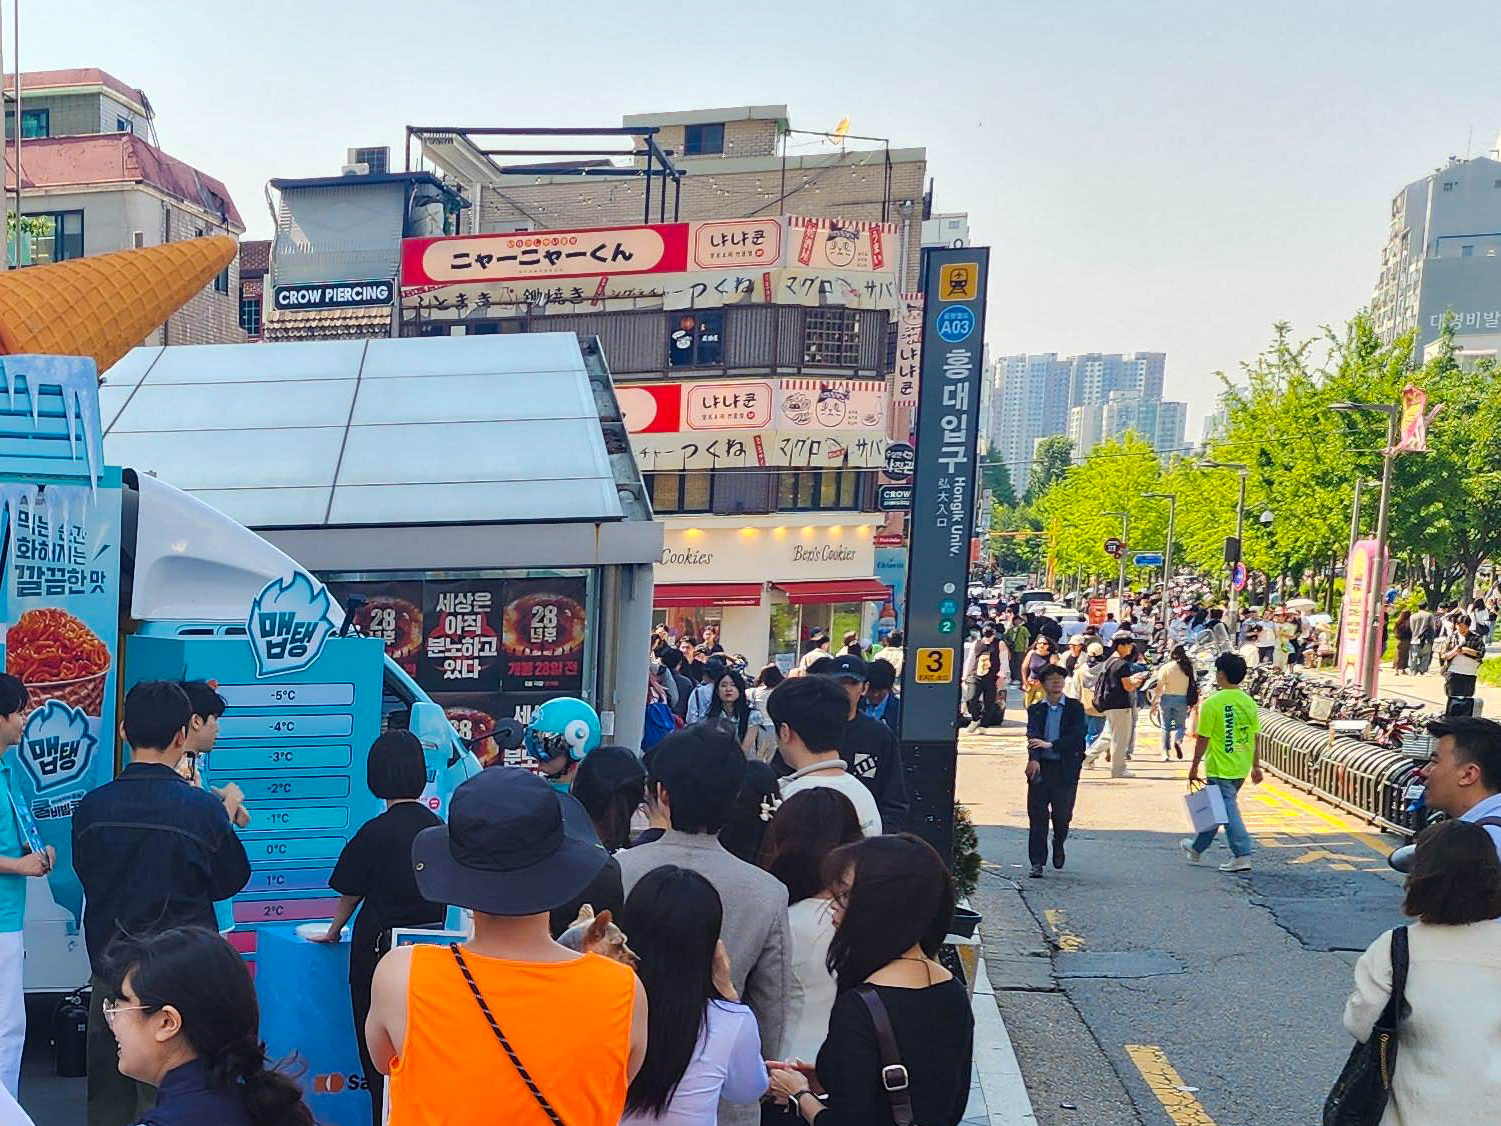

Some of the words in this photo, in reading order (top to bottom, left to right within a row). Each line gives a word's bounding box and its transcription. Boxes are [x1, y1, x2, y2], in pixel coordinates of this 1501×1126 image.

[450, 242, 634, 271] ニャーニャーくん
[278, 289, 322, 305] CROW
[325, 285, 389, 303] PIERCING
[786, 276, 833, 295] マグロ
[864, 280, 894, 299] サバ
[940, 320, 970, 335] A03
[937, 348, 973, 474] 홍대입구
[681, 438, 747, 460] つくね
[780, 438, 821, 457] マグロ
[855, 438, 884, 458] サバ
[884, 490, 912, 498] CROW
[936, 477, 951, 528] 弘大入口
[949, 476, 966, 523] Hongik
[948, 524, 964, 557] Univ.
[793, 545, 821, 562] Ben's
[821, 544, 857, 561] Cookies
[15, 564, 87, 598] 깔끔한
[89, 570, 106, 595] 맛
[435, 591, 493, 613] 세상은
[370, 608, 396, 631] 28
[444, 614, 482, 636] 아직
[529, 604, 558, 628] 28
[942, 621, 951, 632] 2
[257, 611, 319, 660] 맵탱
[427, 636, 498, 658] 분노하고
[443, 659, 482, 680] 있다
[926, 650, 944, 672] 3
[270, 690, 296, 701] -5°C
[268, 721, 295, 732] -4°C
[1224, 704, 1234, 754] SUMMER
[28, 735, 81, 776] 맵탱
[267, 751, 294, 762] -3°C
[266, 783, 293, 794] -2°C
[266, 813, 290, 824] -1°C
[266, 844, 287, 855] 0°C
[266, 875, 285, 886] 1°C
[264, 905, 284, 916] 2°C
